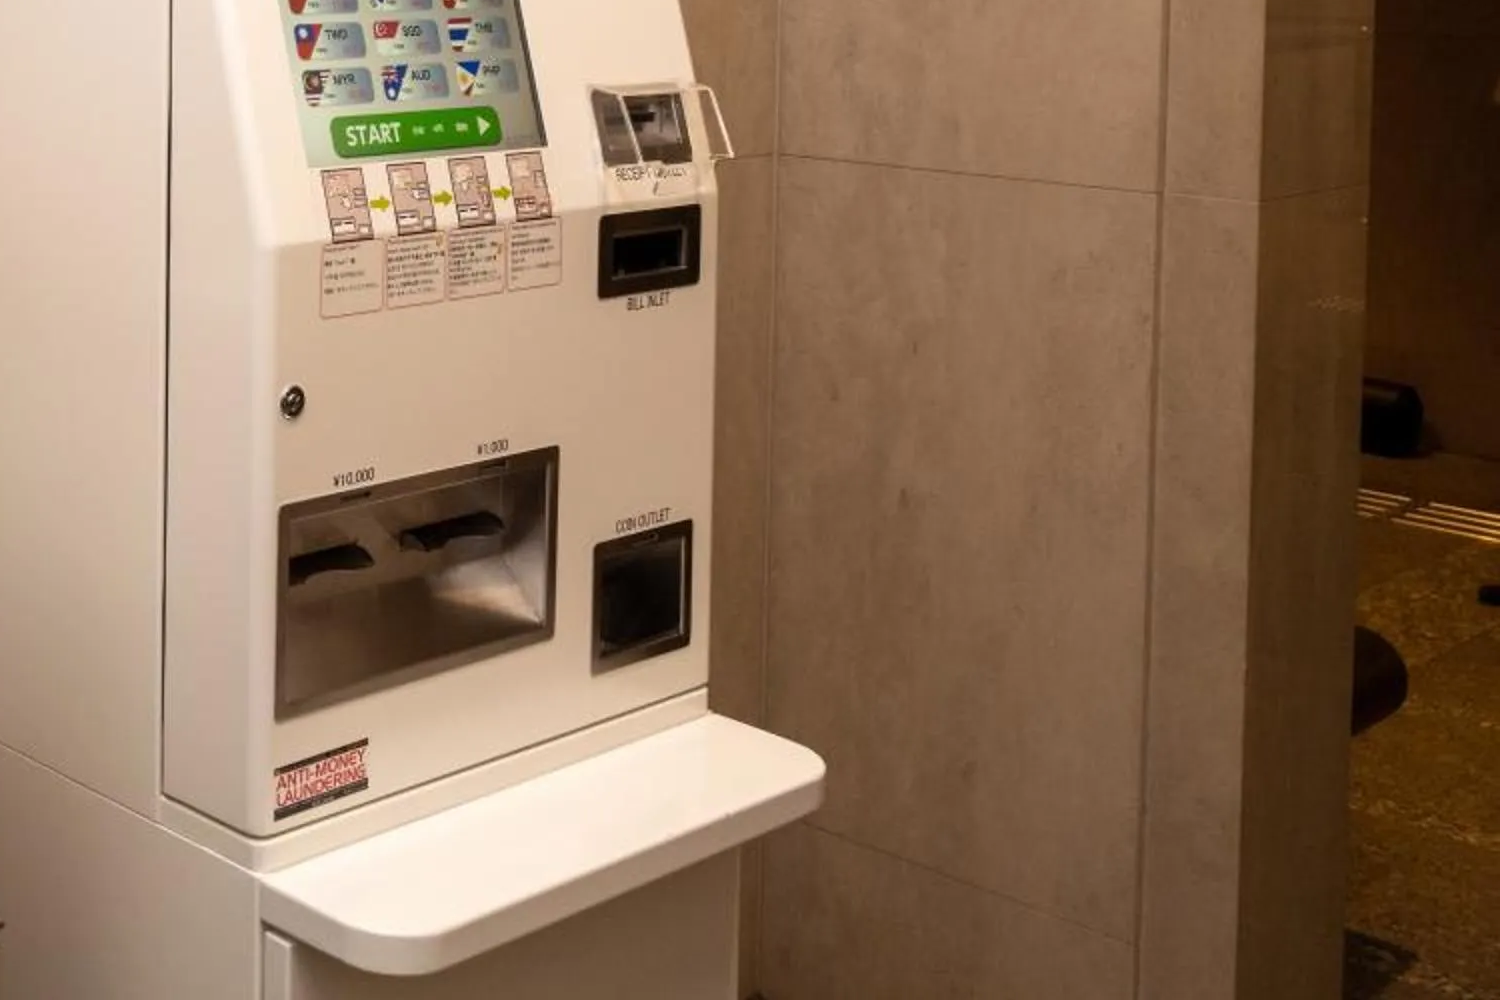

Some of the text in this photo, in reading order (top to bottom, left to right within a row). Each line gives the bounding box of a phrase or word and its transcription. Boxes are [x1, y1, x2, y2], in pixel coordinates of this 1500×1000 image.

[345, 122, 401, 146] START
[627, 291, 670, 311] BILL INLET
[638, 507, 672, 527] OUTLET
[276, 748, 366, 792] ANTI-MONEY
[276, 764, 366, 807] LAUNDERING
